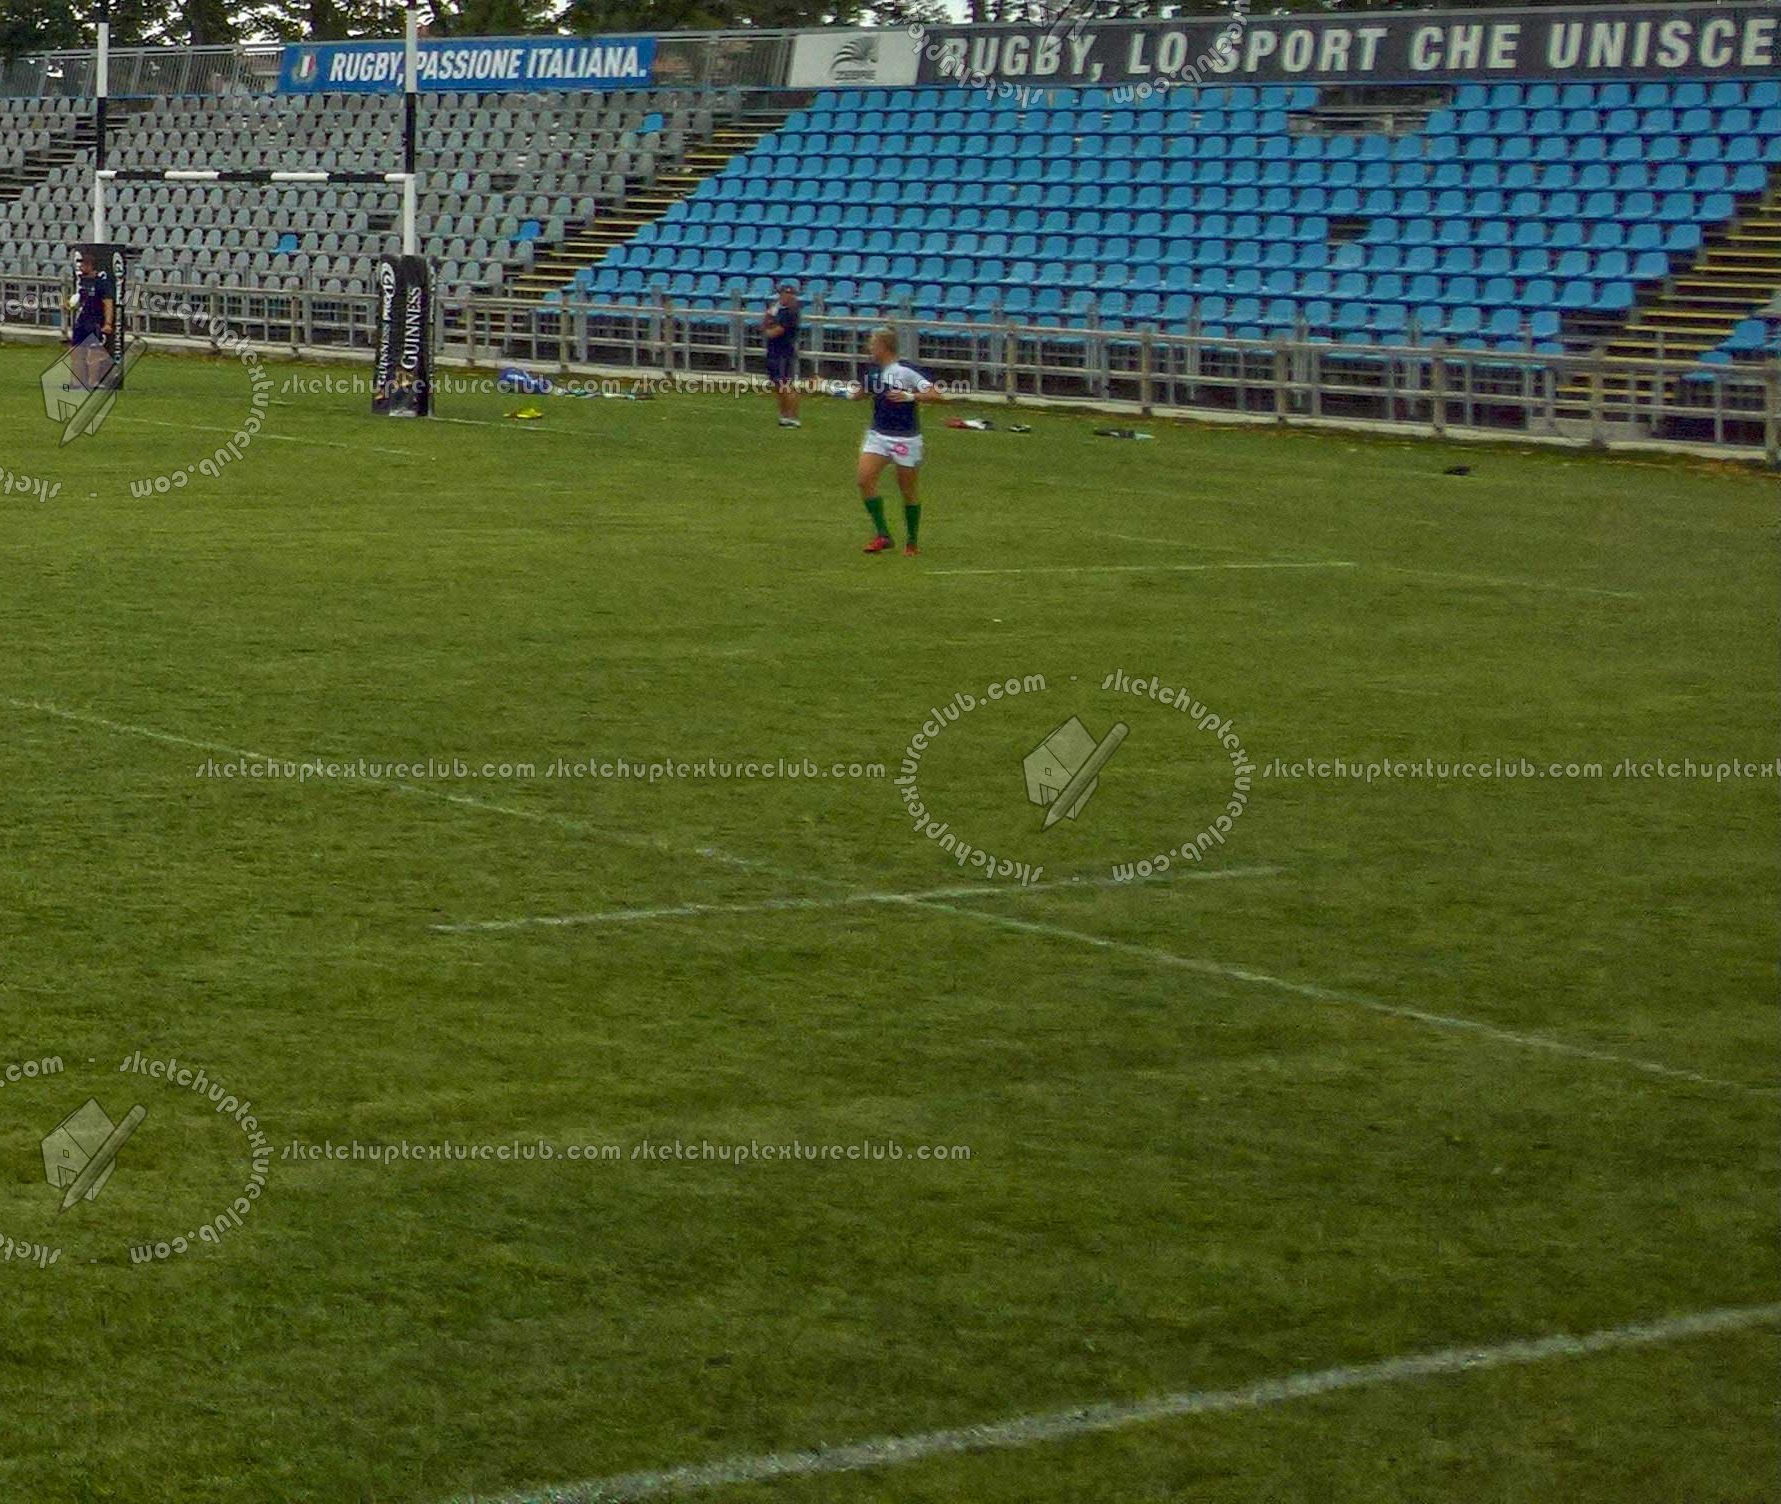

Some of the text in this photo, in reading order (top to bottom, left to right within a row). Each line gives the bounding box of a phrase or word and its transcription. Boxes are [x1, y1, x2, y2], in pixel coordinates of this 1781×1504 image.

[329, 47, 647, 86] RUGBY, PASSIONE ITALIANA.
[939, 18, 1777, 82] RUGBY, LO SPORT CHE UNISCE
[400, 286, 422, 369] GUINNESS
